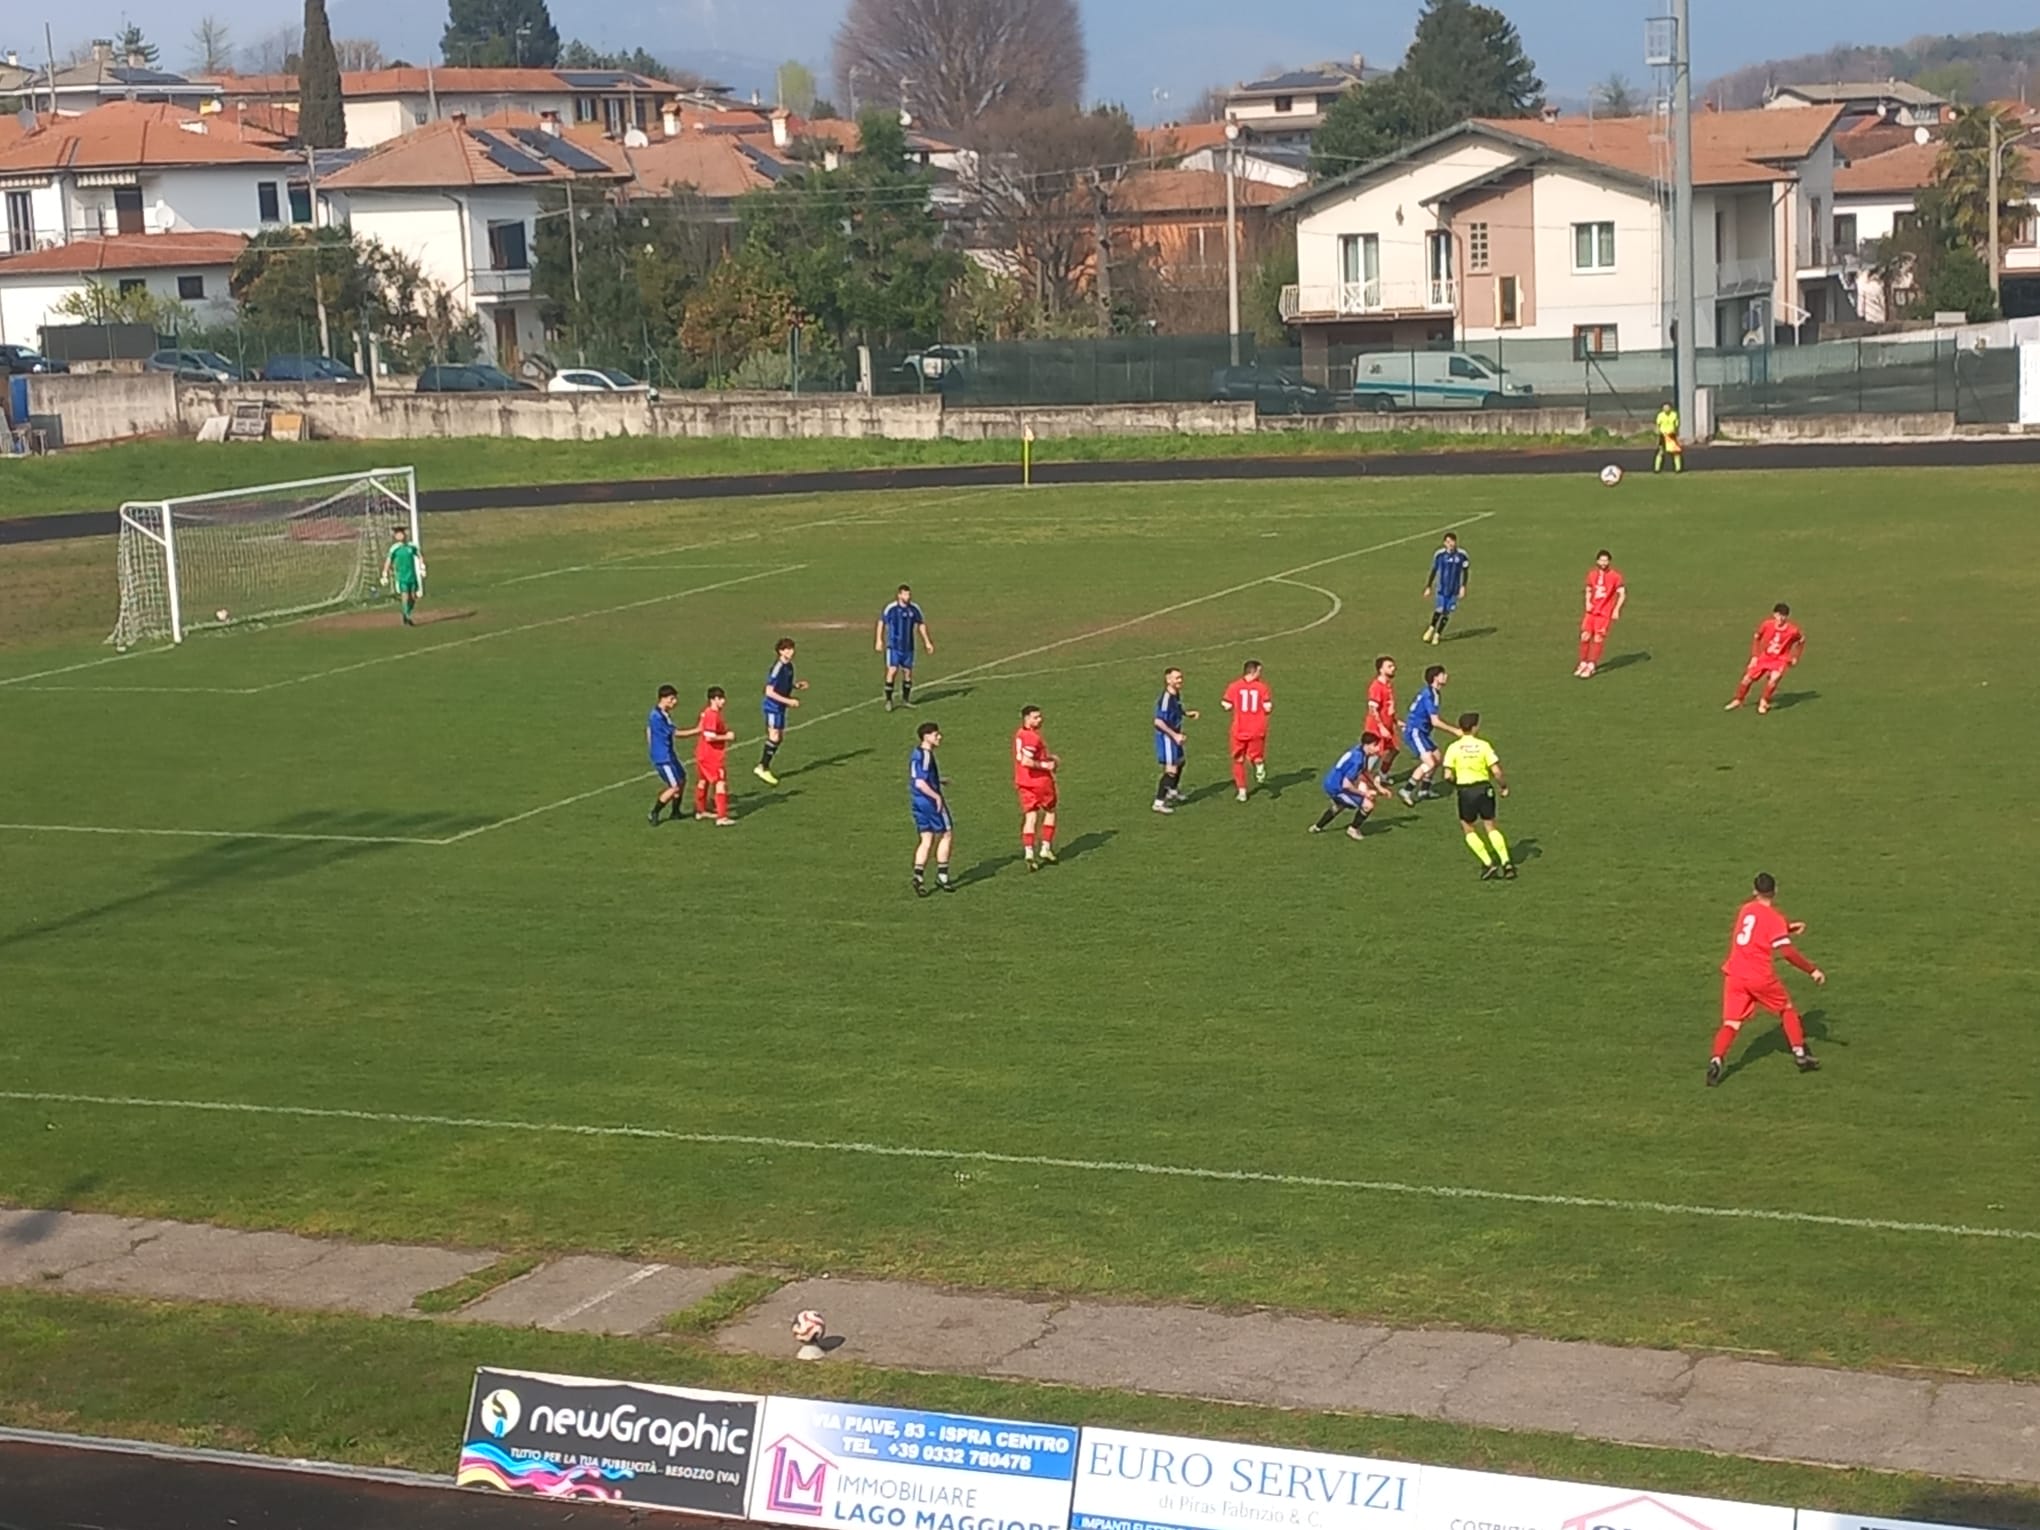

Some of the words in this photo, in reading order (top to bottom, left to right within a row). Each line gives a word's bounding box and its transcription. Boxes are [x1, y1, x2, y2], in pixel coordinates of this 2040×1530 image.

[1239, 689, 1259, 713] 11
[1736, 914, 1756, 946] 3
[529, 1404, 749, 1457] newGraphic
[812, 1414, 841, 1430] VIA
[845, 1416, 900, 1439] PIAVE,
[904, 1422, 926, 1439] 83
[939, 1425, 992, 1446] ISPRA
[995, 1432, 1069, 1453] CENTRO
[510, 1447, 542, 1460] TUTTO
[543, 1451, 561, 1463] PER
[563, 1454, 577, 1464] LA
[580, 1455, 599, 1467] TUA
[601, 1457, 657, 1474] PUBBLICITÀ
[665, 1465, 715, 1481] BESOZZO
[842, 1437, 879, 1455] TEL.
[888, 1442, 919, 1459] +39
[922, 1445, 965, 1464] 0332
[837, 1474, 977, 1508] IMMOBILIARE
[1087, 1442, 1214, 1488] EURO
[1230, 1458, 1409, 1511] SERVIZI
[834, 1500, 906, 1526] LAGO
[915, 1510, 1060, 1530] MAGGIO
